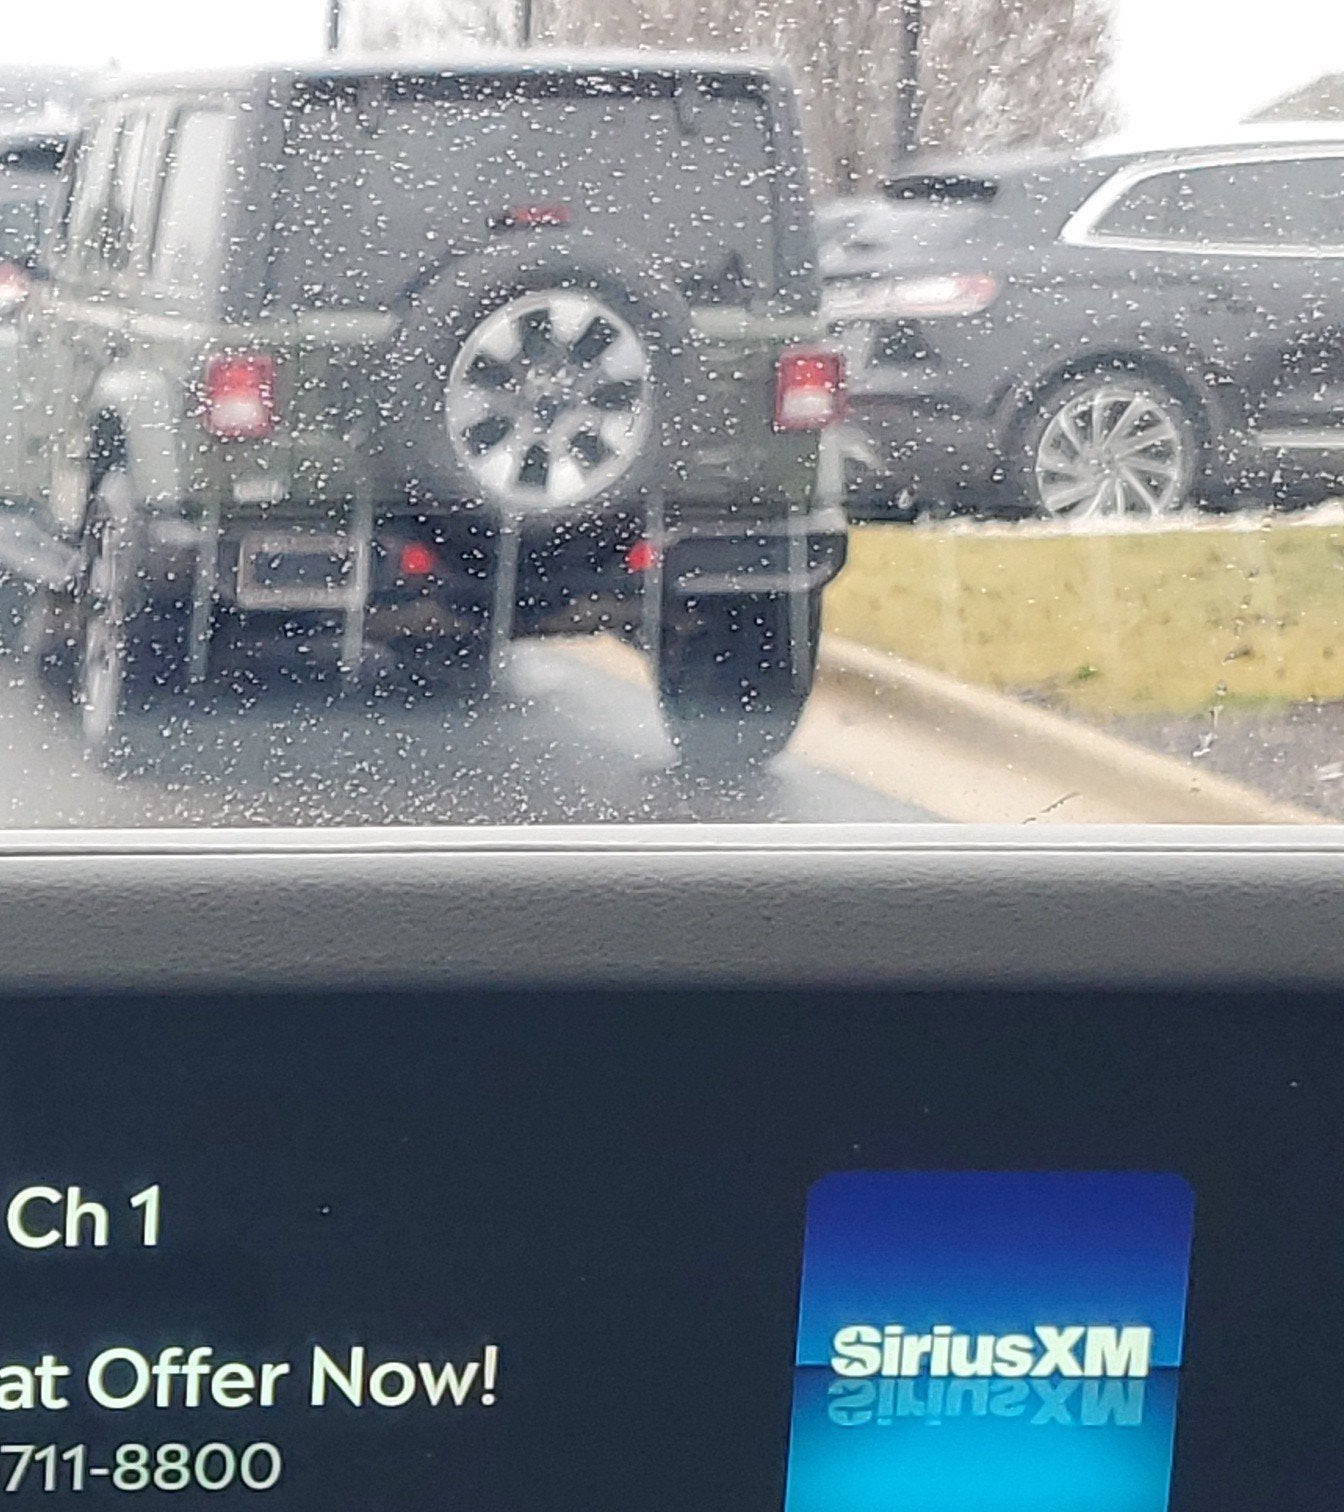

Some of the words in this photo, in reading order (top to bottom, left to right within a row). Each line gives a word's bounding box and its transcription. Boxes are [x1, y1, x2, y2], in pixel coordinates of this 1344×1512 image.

[5, 1184, 108, 1248] Ch
[128, 1185, 162, 1247] 1
[86, 1347, 290, 1408] Offer
[310, 1345, 500, 1406] Now!
[829, 1324, 1153, 1378] SiriusXM
